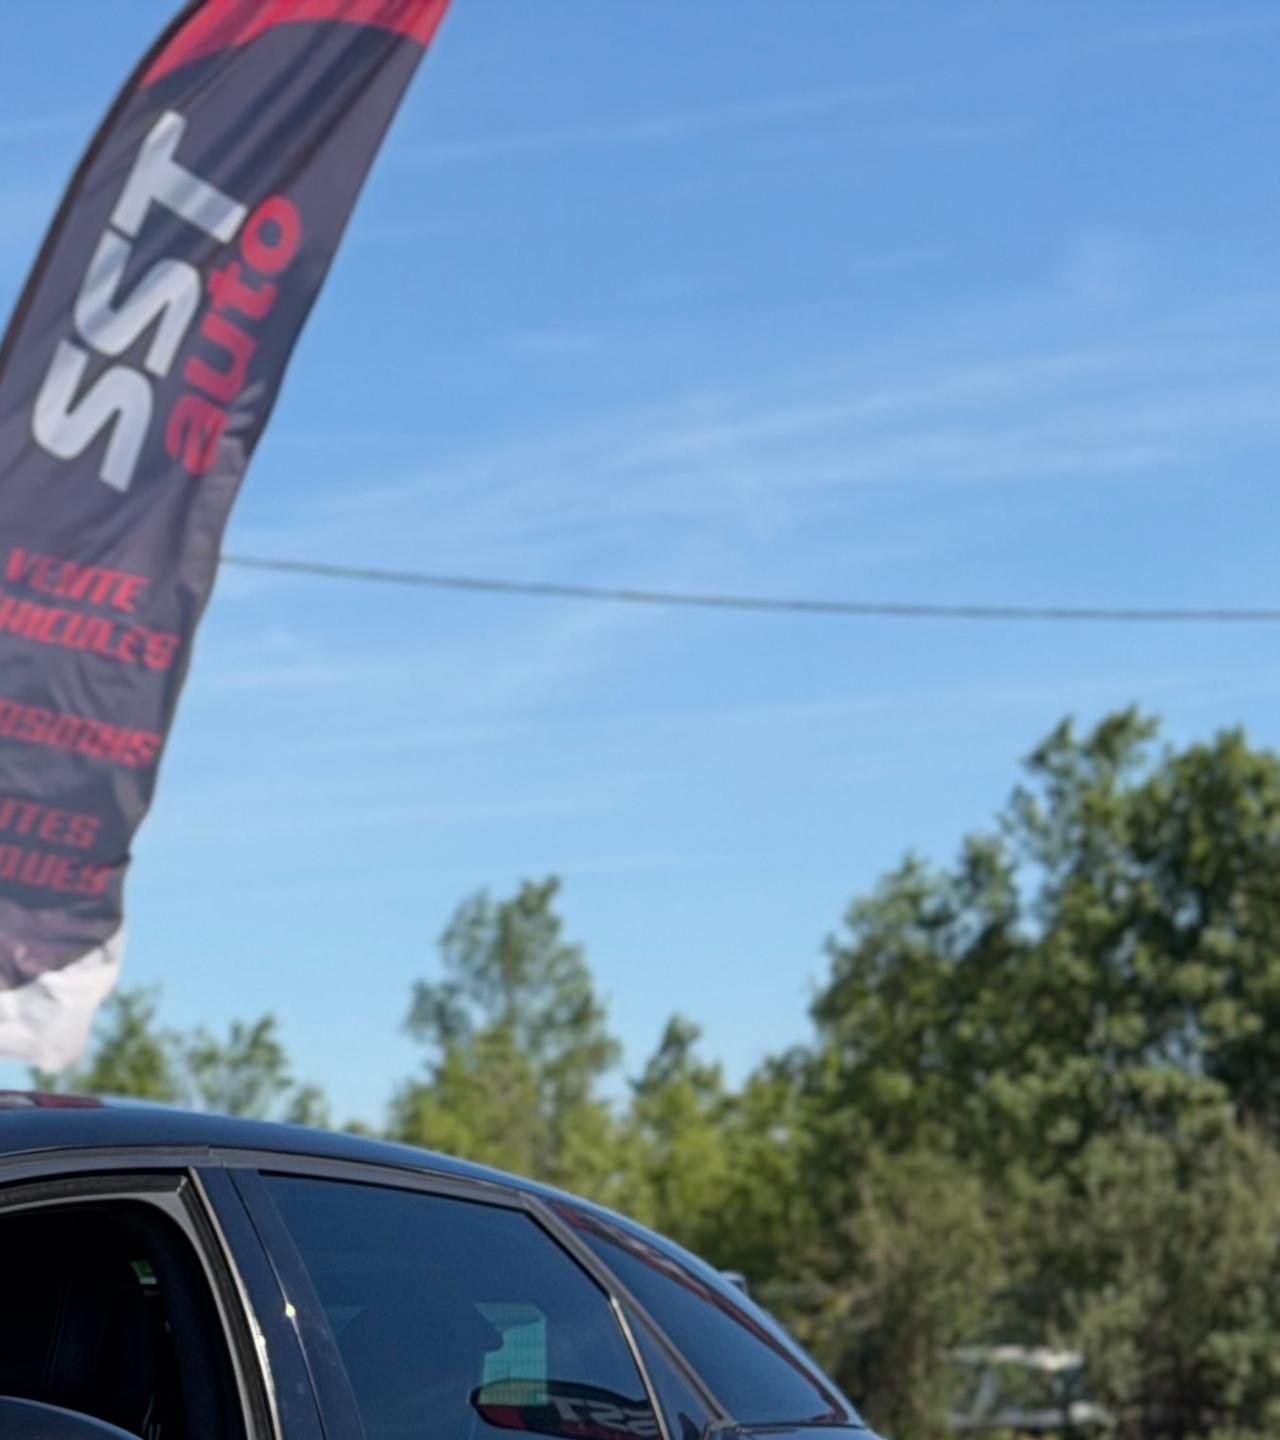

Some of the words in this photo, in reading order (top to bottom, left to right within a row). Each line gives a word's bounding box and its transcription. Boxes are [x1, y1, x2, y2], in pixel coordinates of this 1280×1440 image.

[32, 109, 248, 493] SST
[165, 196, 302, 477] auto
[5, 547, 152, 614] VENTE
